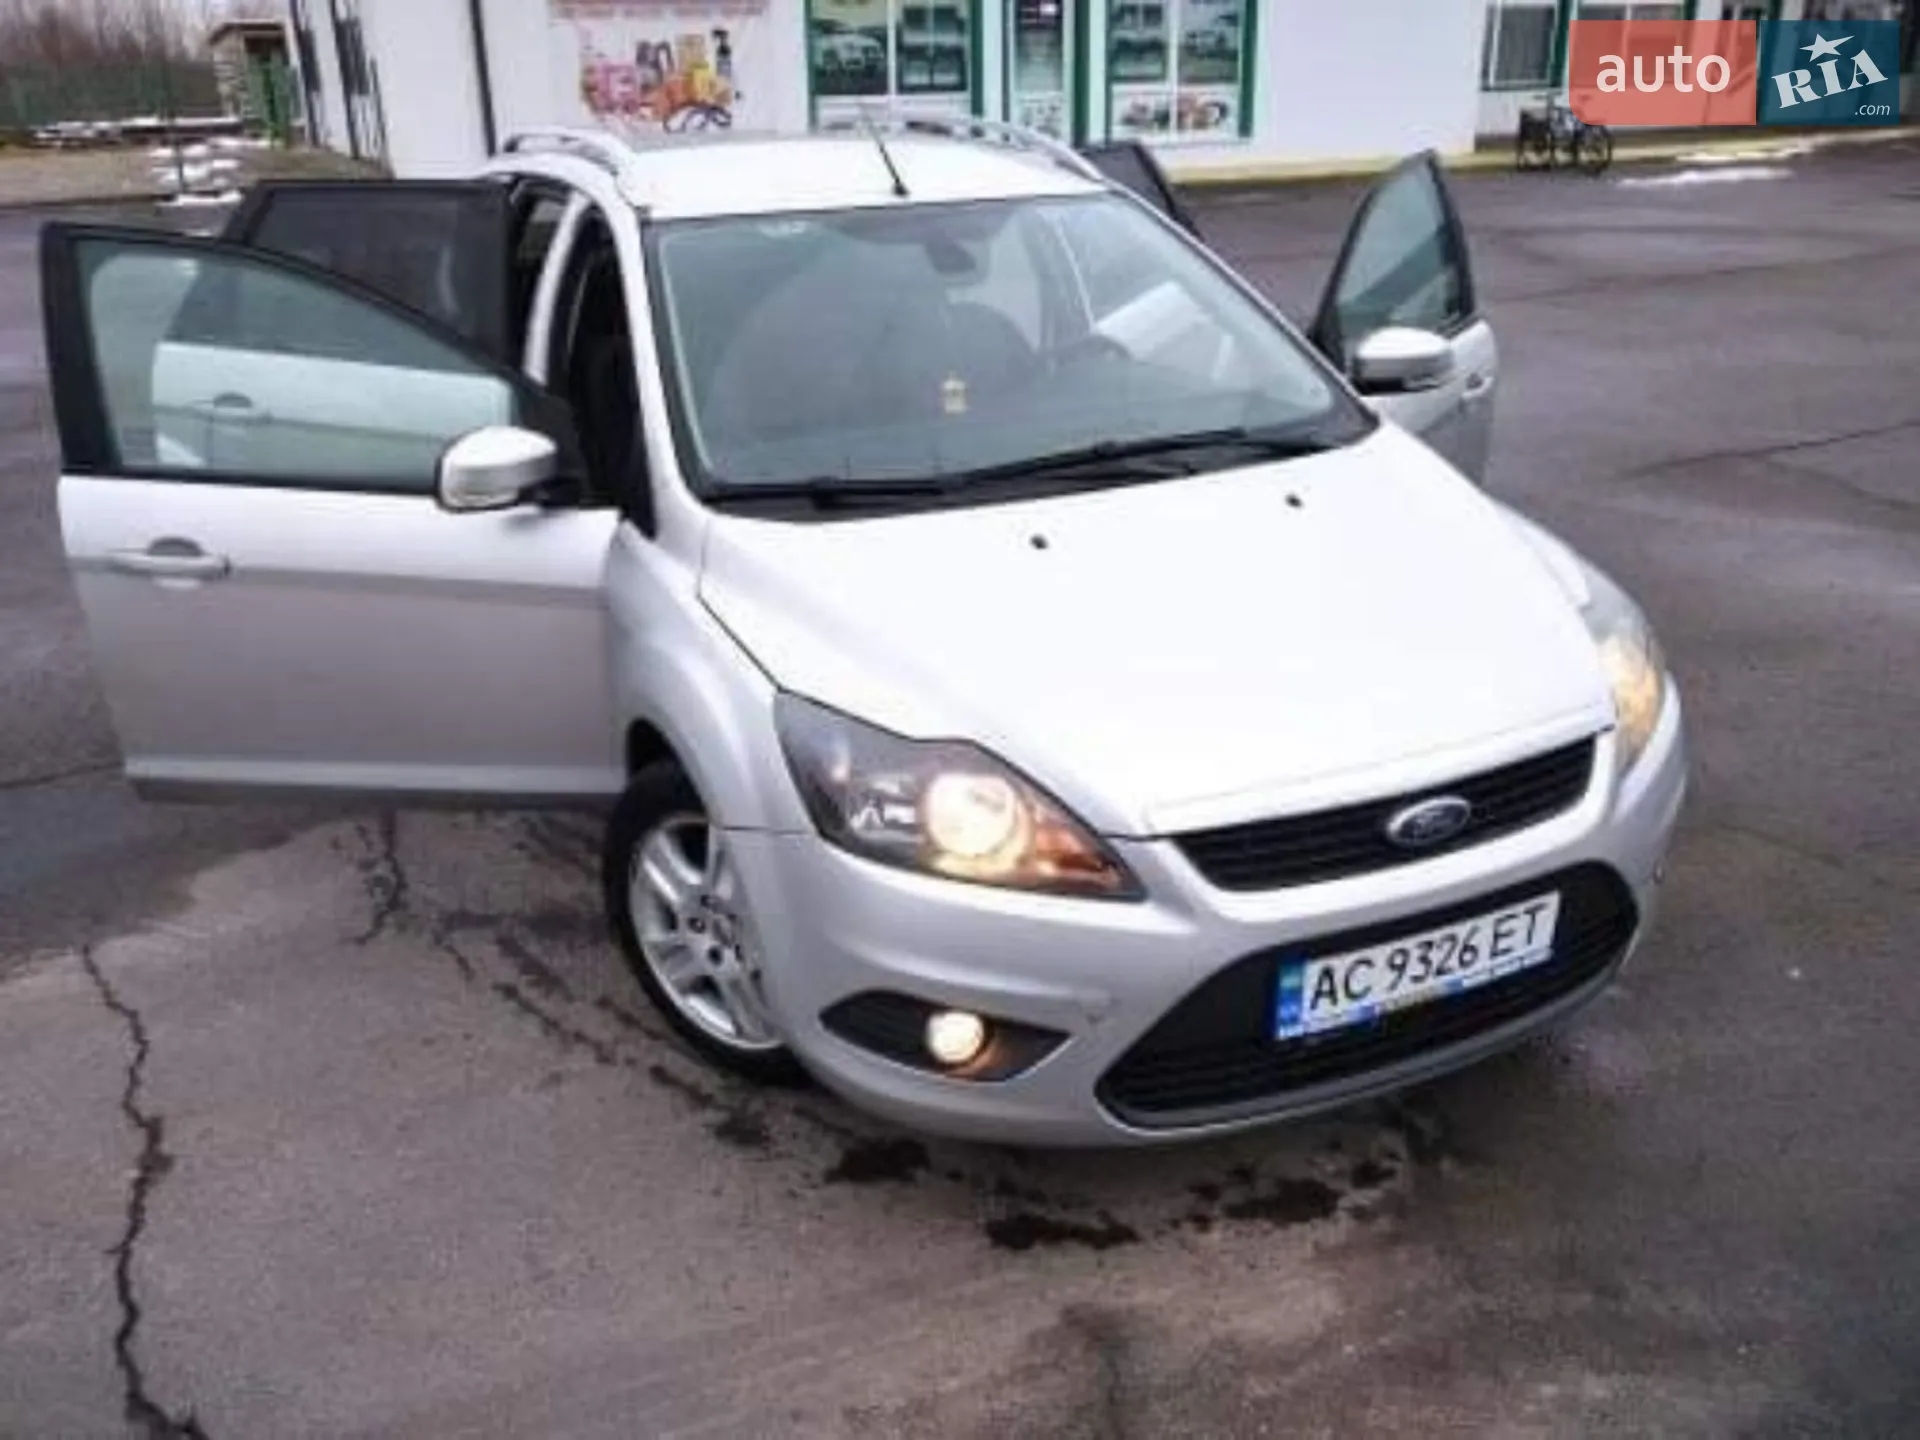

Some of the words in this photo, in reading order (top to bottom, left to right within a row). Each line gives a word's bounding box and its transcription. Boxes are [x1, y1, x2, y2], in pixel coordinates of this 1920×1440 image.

[1310, 959, 1374, 1010] AC
[1386, 928, 1479, 990] 9326
[1490, 902, 1546, 956] ET
